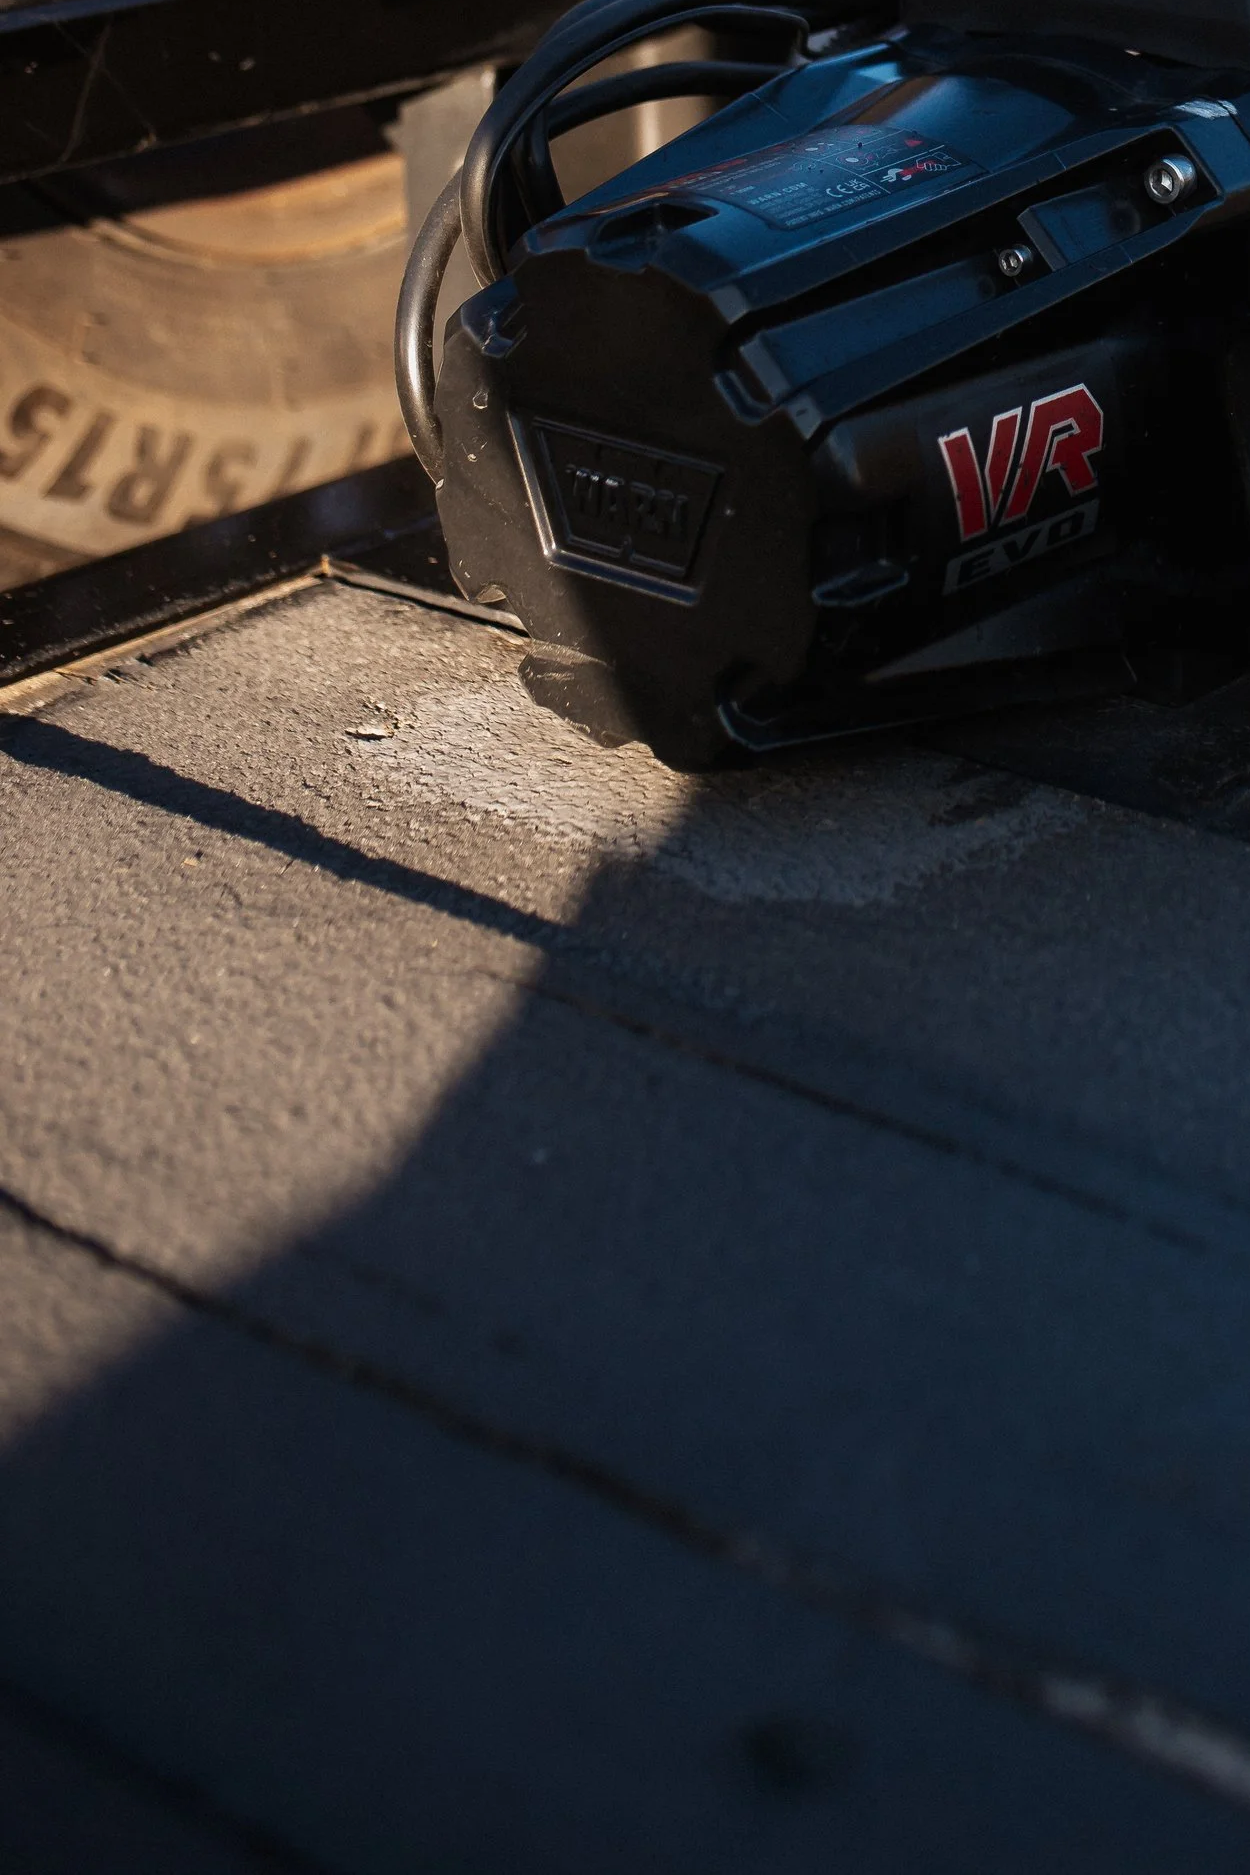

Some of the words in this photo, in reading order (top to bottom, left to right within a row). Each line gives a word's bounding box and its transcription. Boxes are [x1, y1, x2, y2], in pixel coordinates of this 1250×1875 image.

[825, 183, 854, 198] CE
[938, 382, 1104, 545] VR
[954, 507, 1088, 587] EVO
